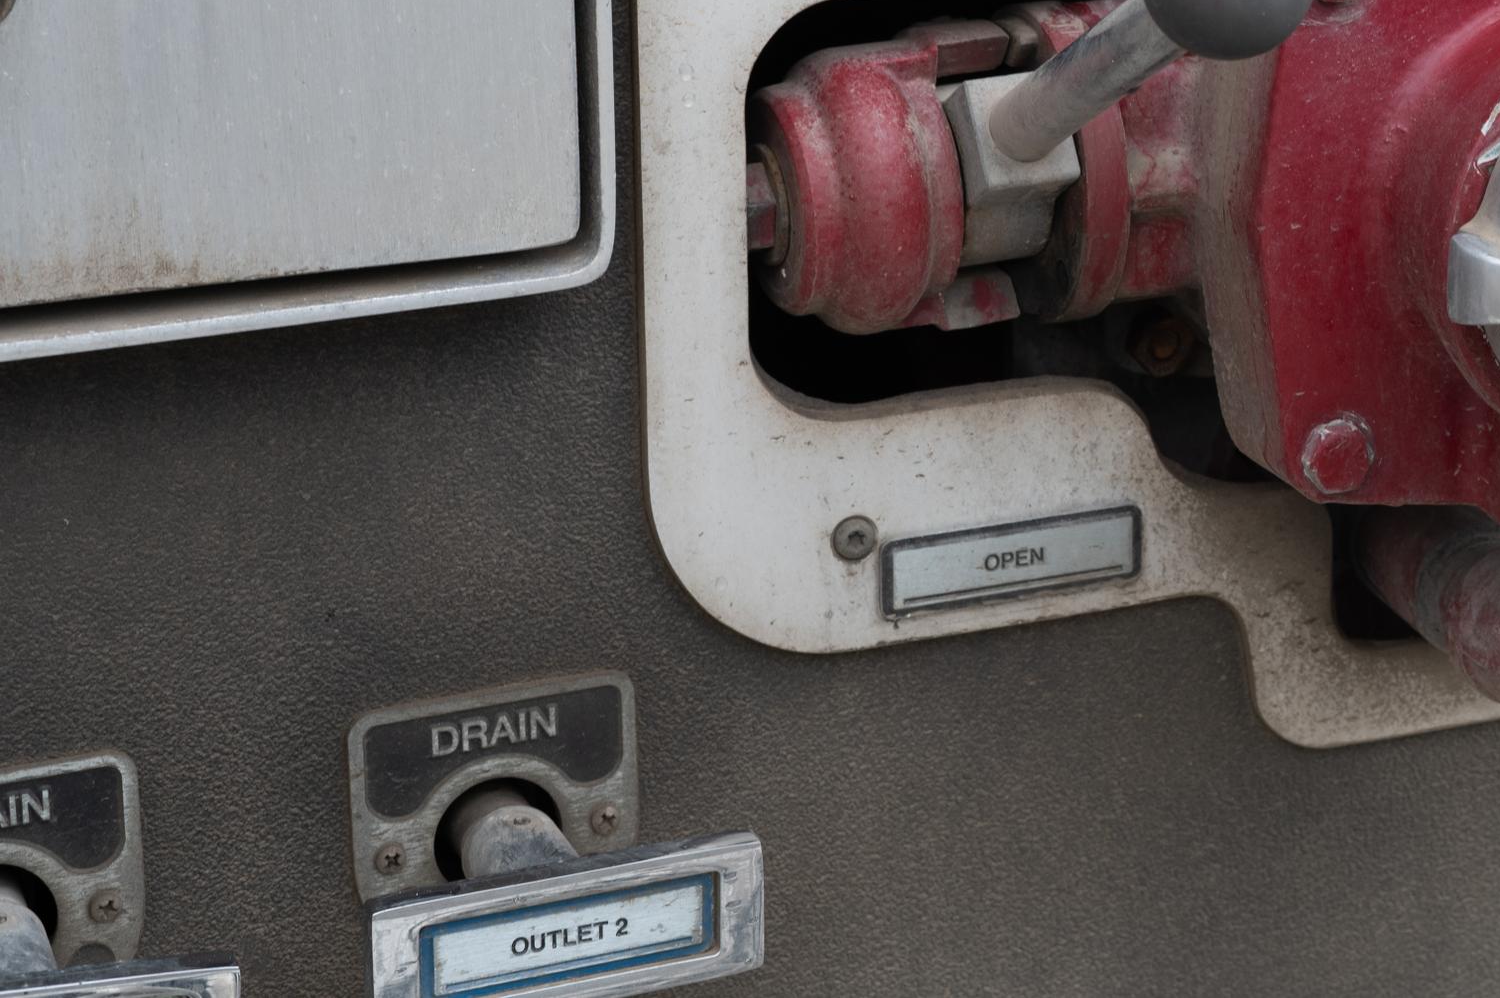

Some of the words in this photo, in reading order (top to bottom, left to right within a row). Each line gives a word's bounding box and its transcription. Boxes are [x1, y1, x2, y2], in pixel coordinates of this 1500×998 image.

[984, 547, 1044, 571] OPEN
[431, 706, 557, 756] DRAIN
[0, 789, 51, 828] IN
[511, 920, 609, 955] OUTLET
[615, 917, 628, 937] 2
